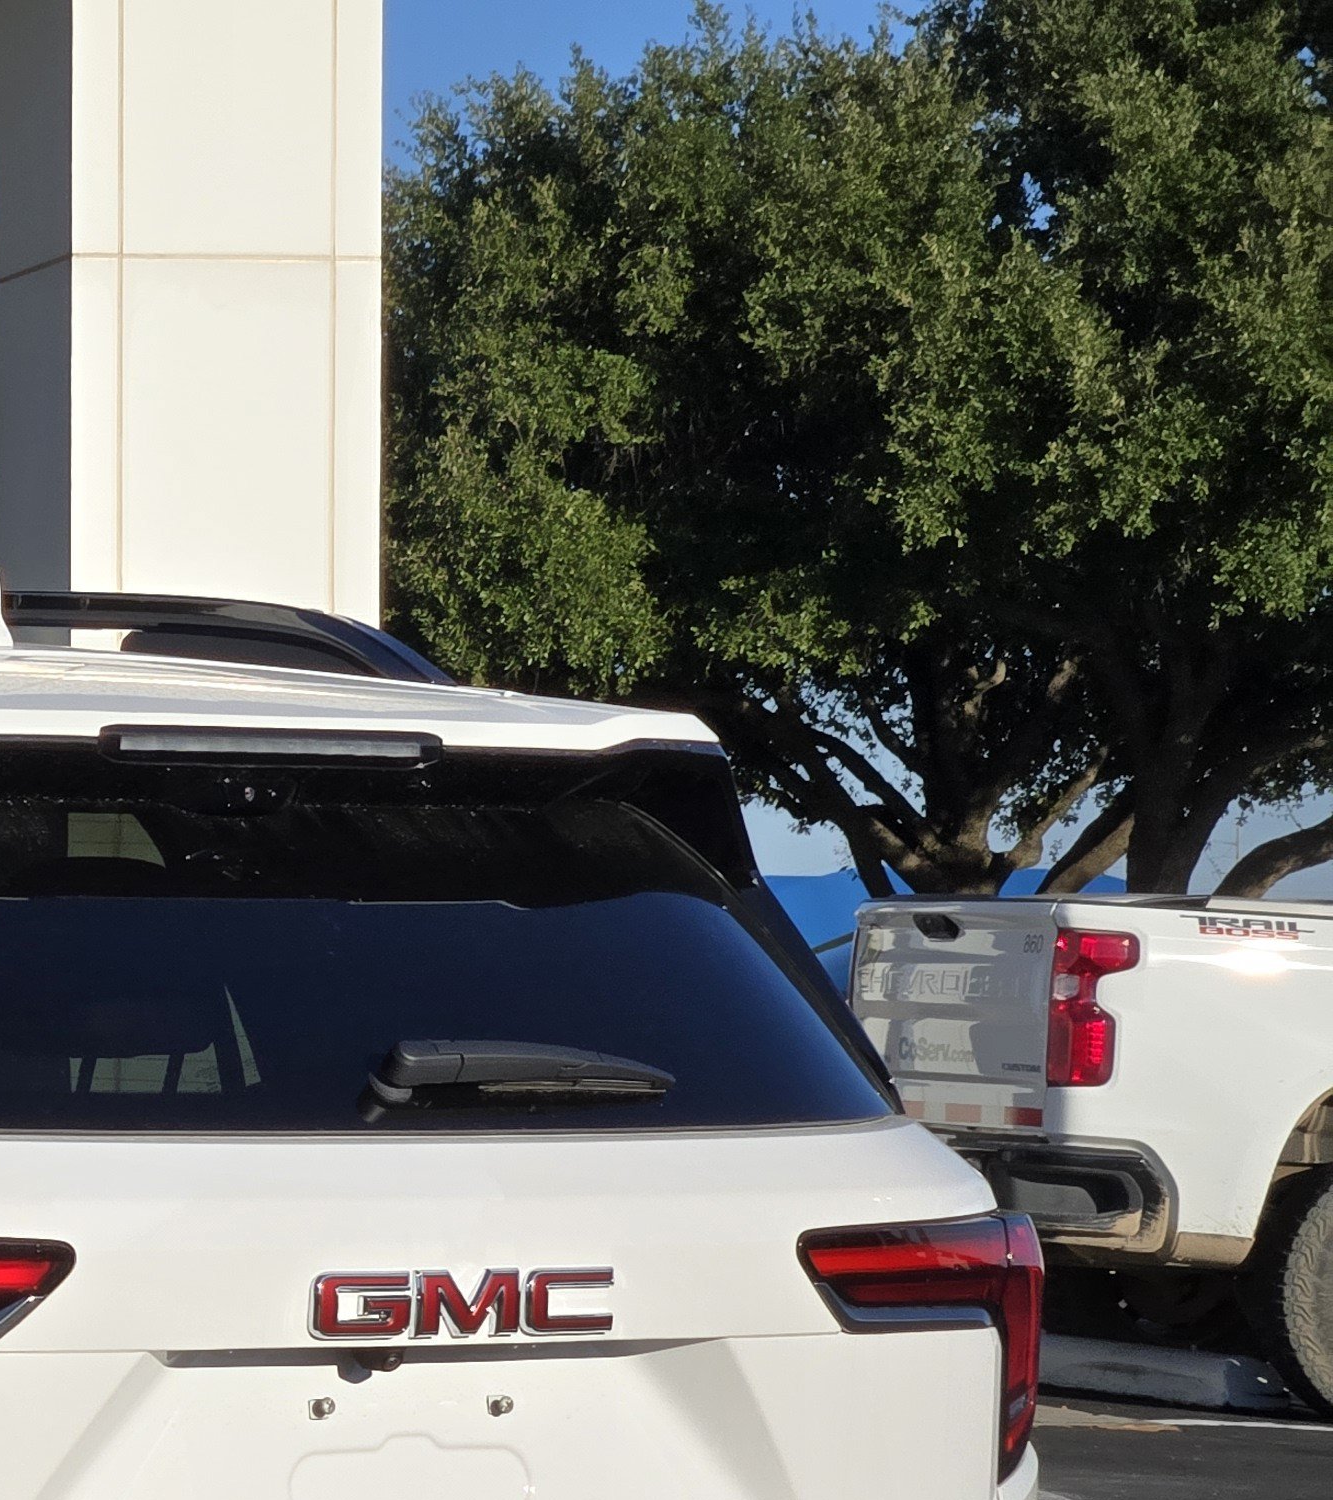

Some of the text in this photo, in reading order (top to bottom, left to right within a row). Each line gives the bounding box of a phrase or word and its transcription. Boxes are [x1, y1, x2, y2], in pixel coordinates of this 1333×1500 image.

[1180, 914, 1316, 934] TRAIL
[1199, 926, 1300, 941] BOSS
[307, 1265, 615, 1341] GMC
